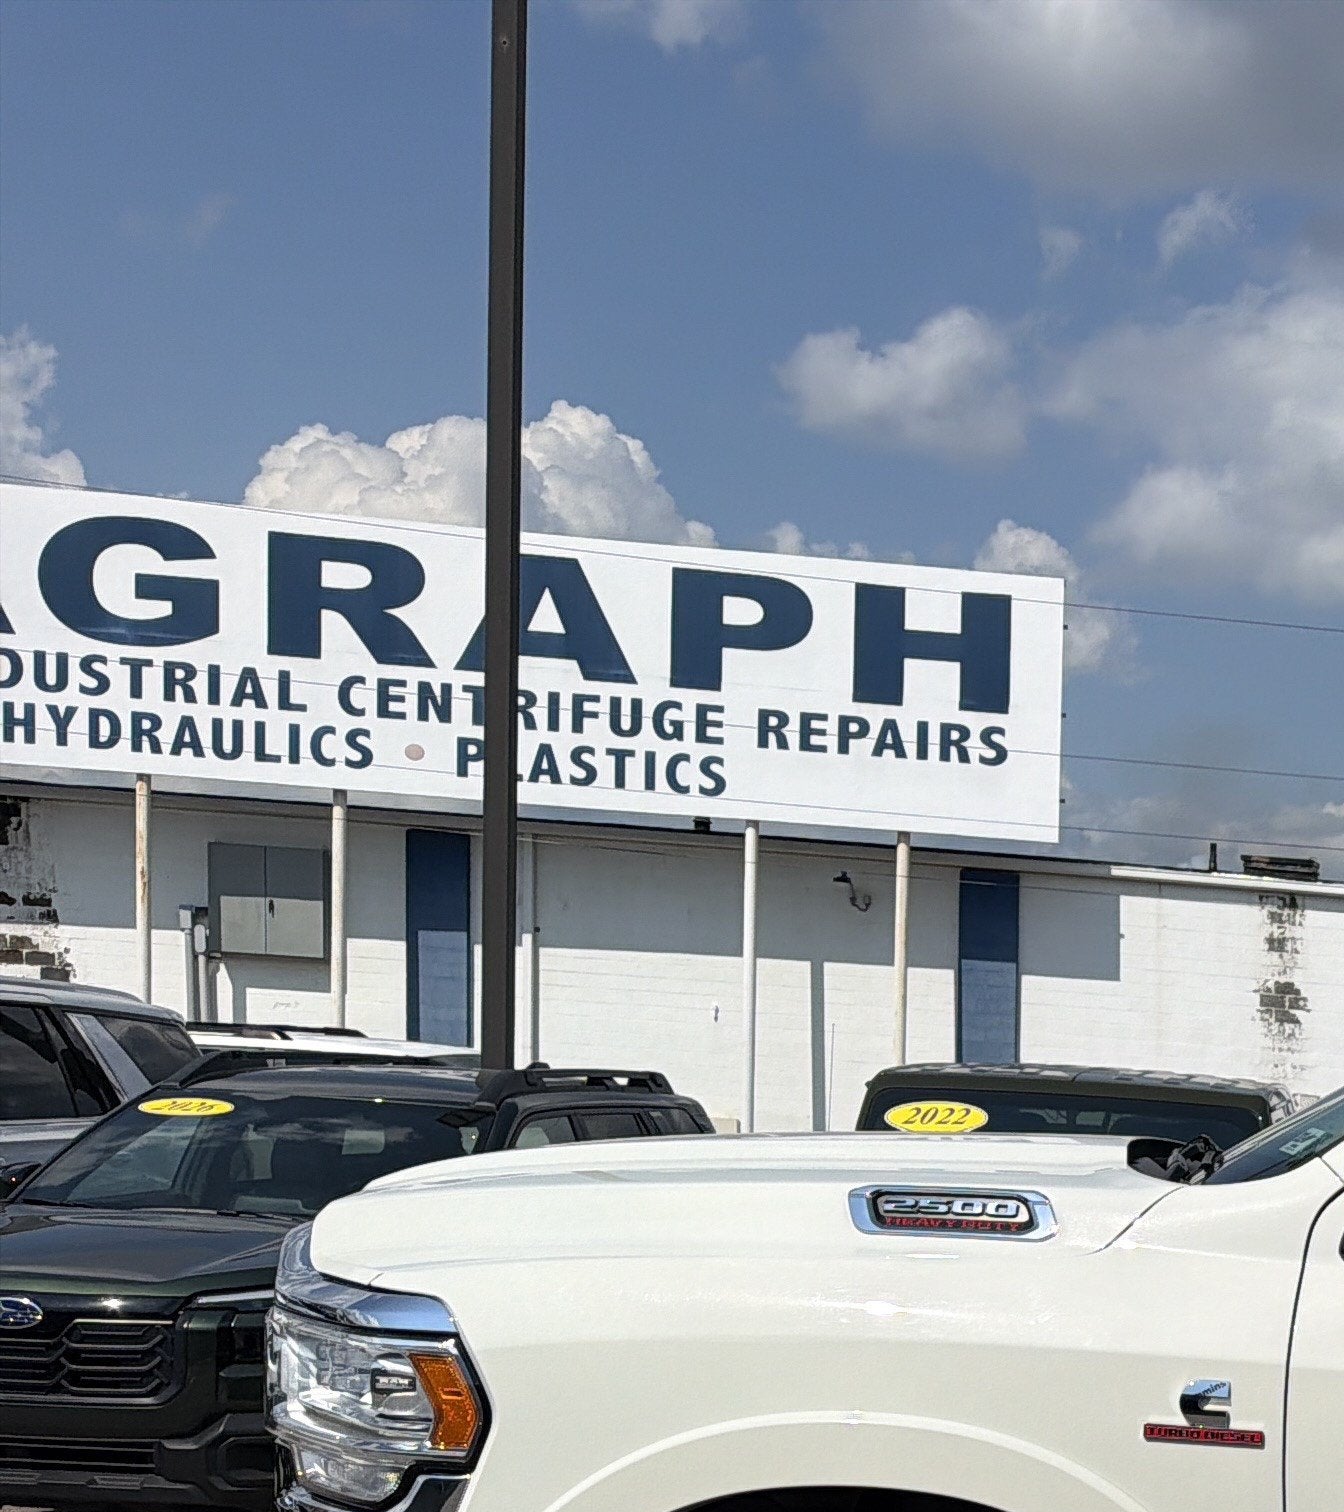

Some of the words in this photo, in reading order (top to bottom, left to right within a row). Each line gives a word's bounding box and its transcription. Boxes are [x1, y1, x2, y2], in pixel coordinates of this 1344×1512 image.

[0, 515, 1013, 715] GRAPH
[2, 700, 375, 770] HYDRAULICS
[456, 736, 728, 798] PASTICS
[757, 707, 1010, 767] REPAIRS
[901, 1106, 972, 1126] 2022
[882, 1196, 1021, 1219] 2500
